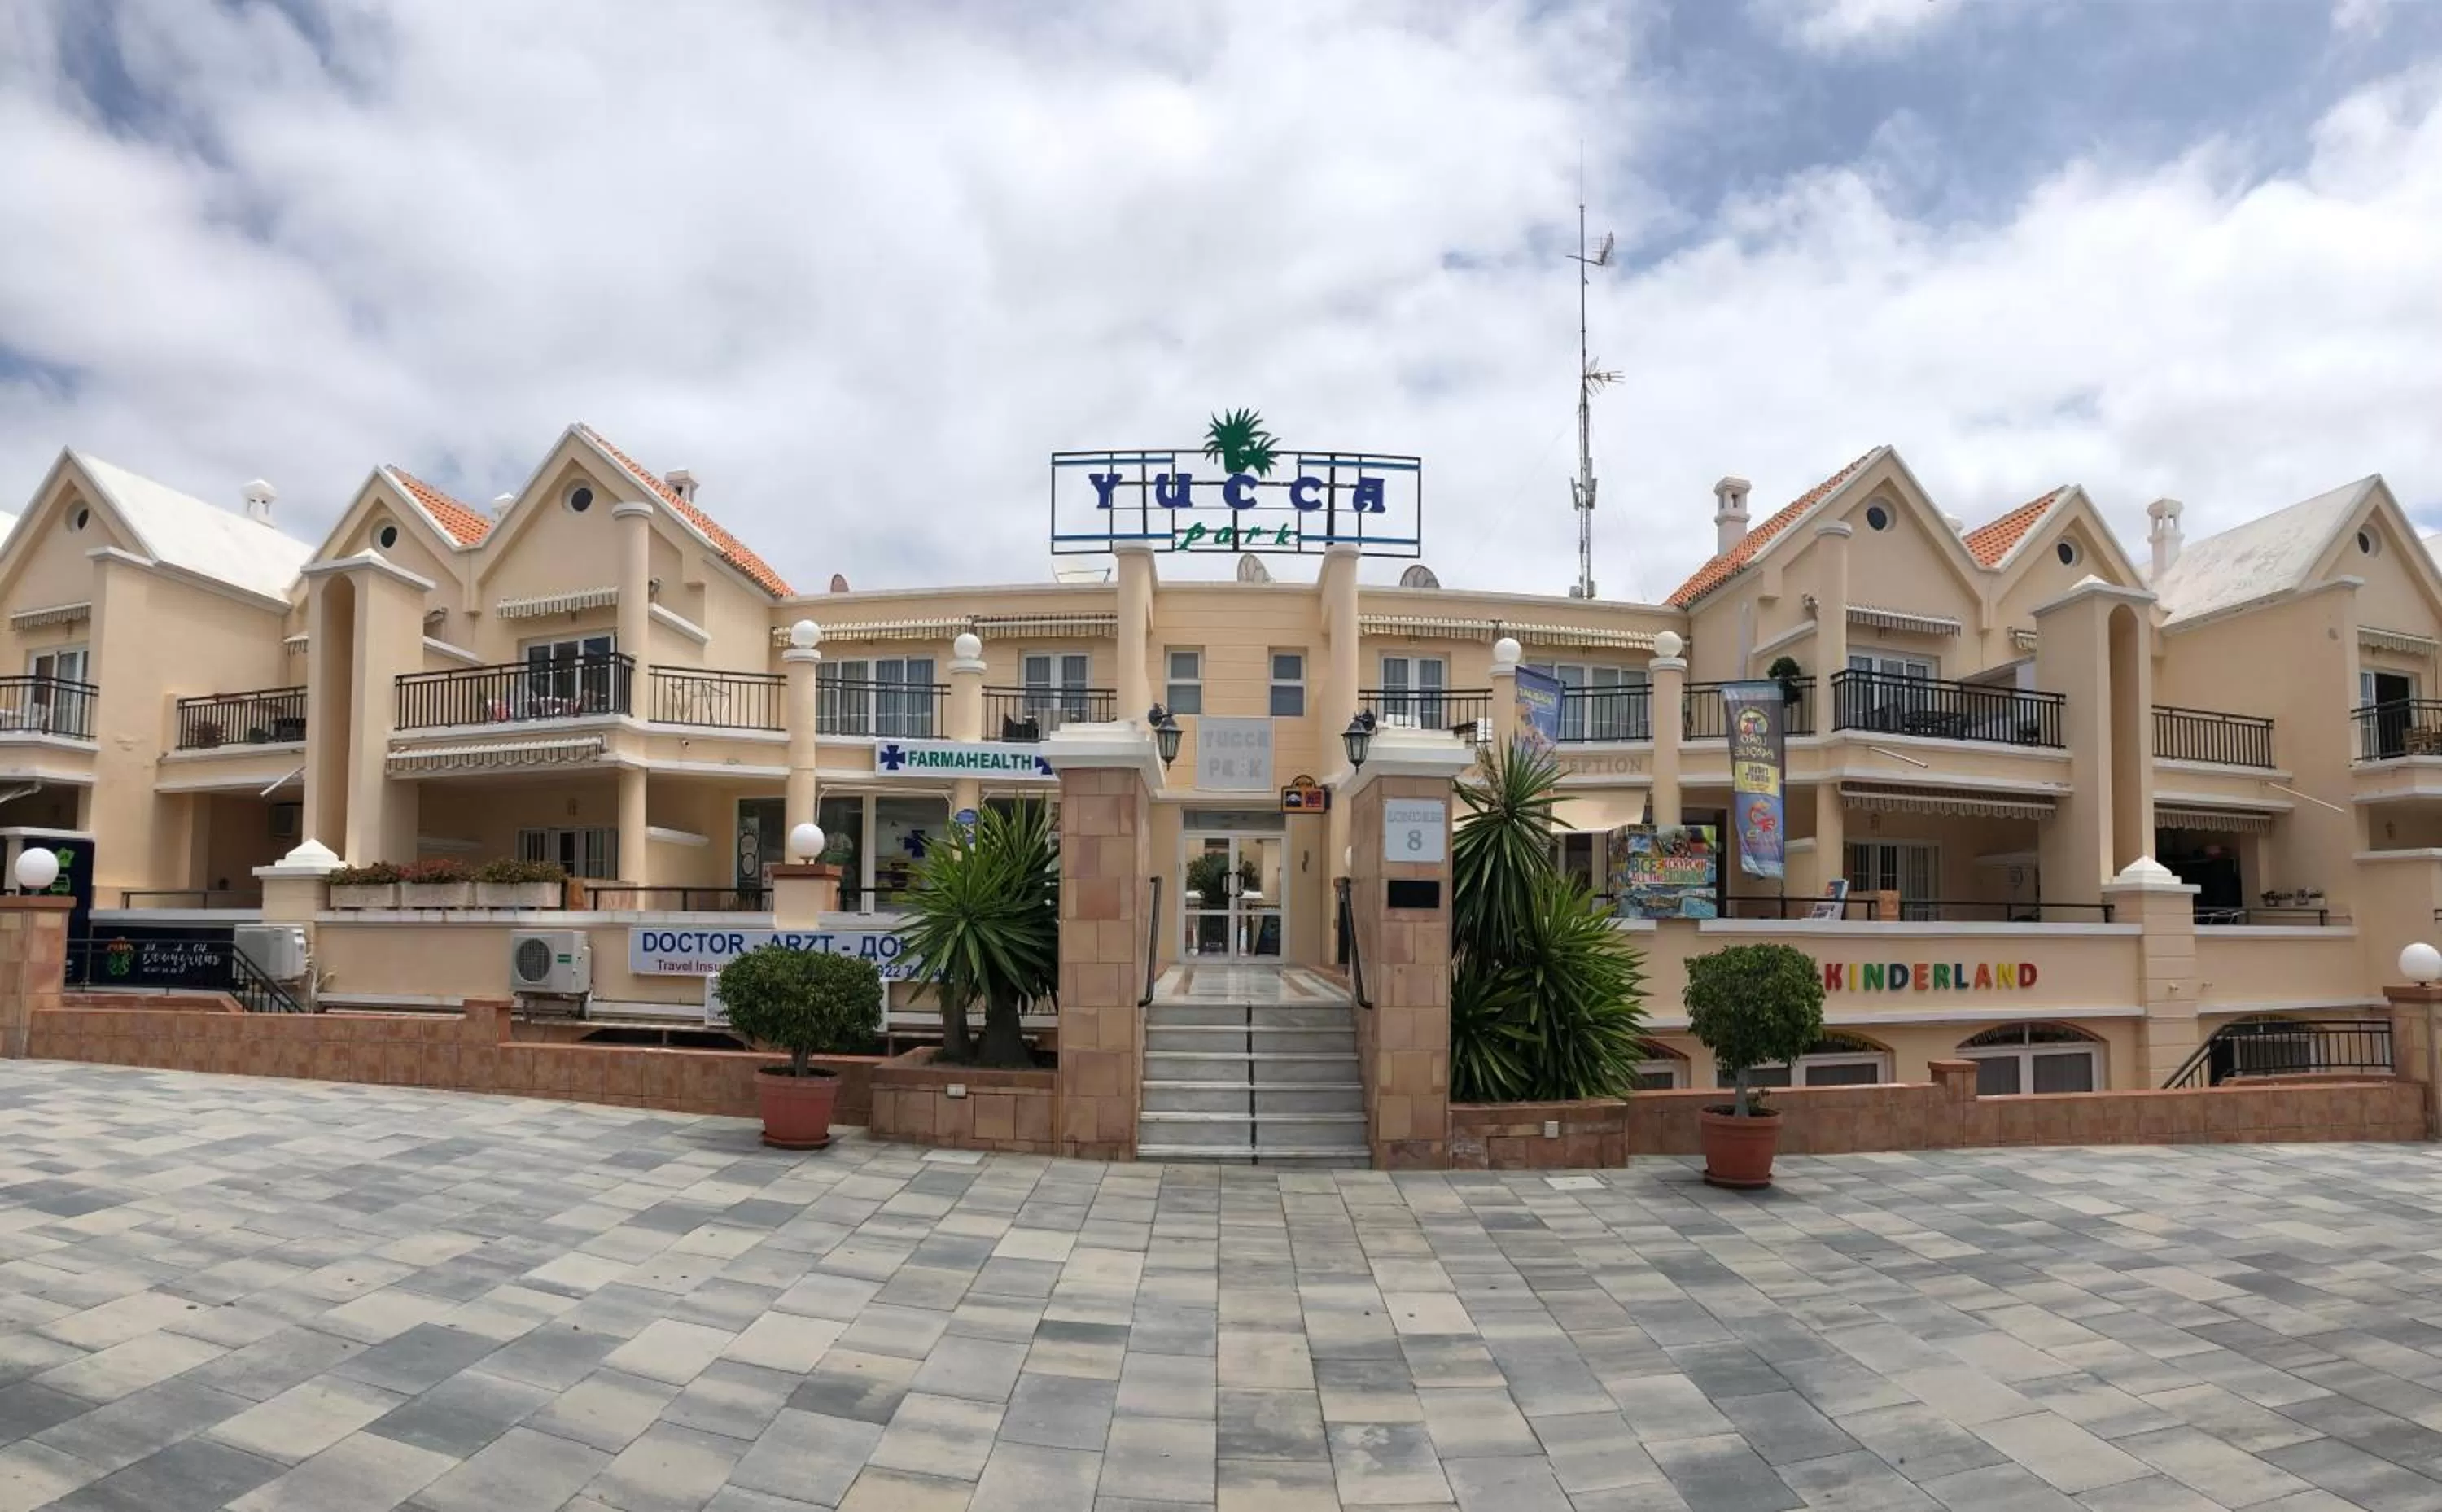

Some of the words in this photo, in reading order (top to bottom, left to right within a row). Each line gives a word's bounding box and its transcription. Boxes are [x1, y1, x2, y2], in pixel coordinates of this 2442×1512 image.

[1088, 473, 1385, 513] YUCCA
[1176, 522, 1290, 551] park
[908, 751, 1032, 770] FARMAHEALTH
[1406, 829, 1423, 852] 8
[642, 932, 746, 955] DOCTOR
[770, 933, 834, 955] ARZT
[656, 960, 692, 972] Travel
[1824, 963, 2038, 991] KINDERLAND
